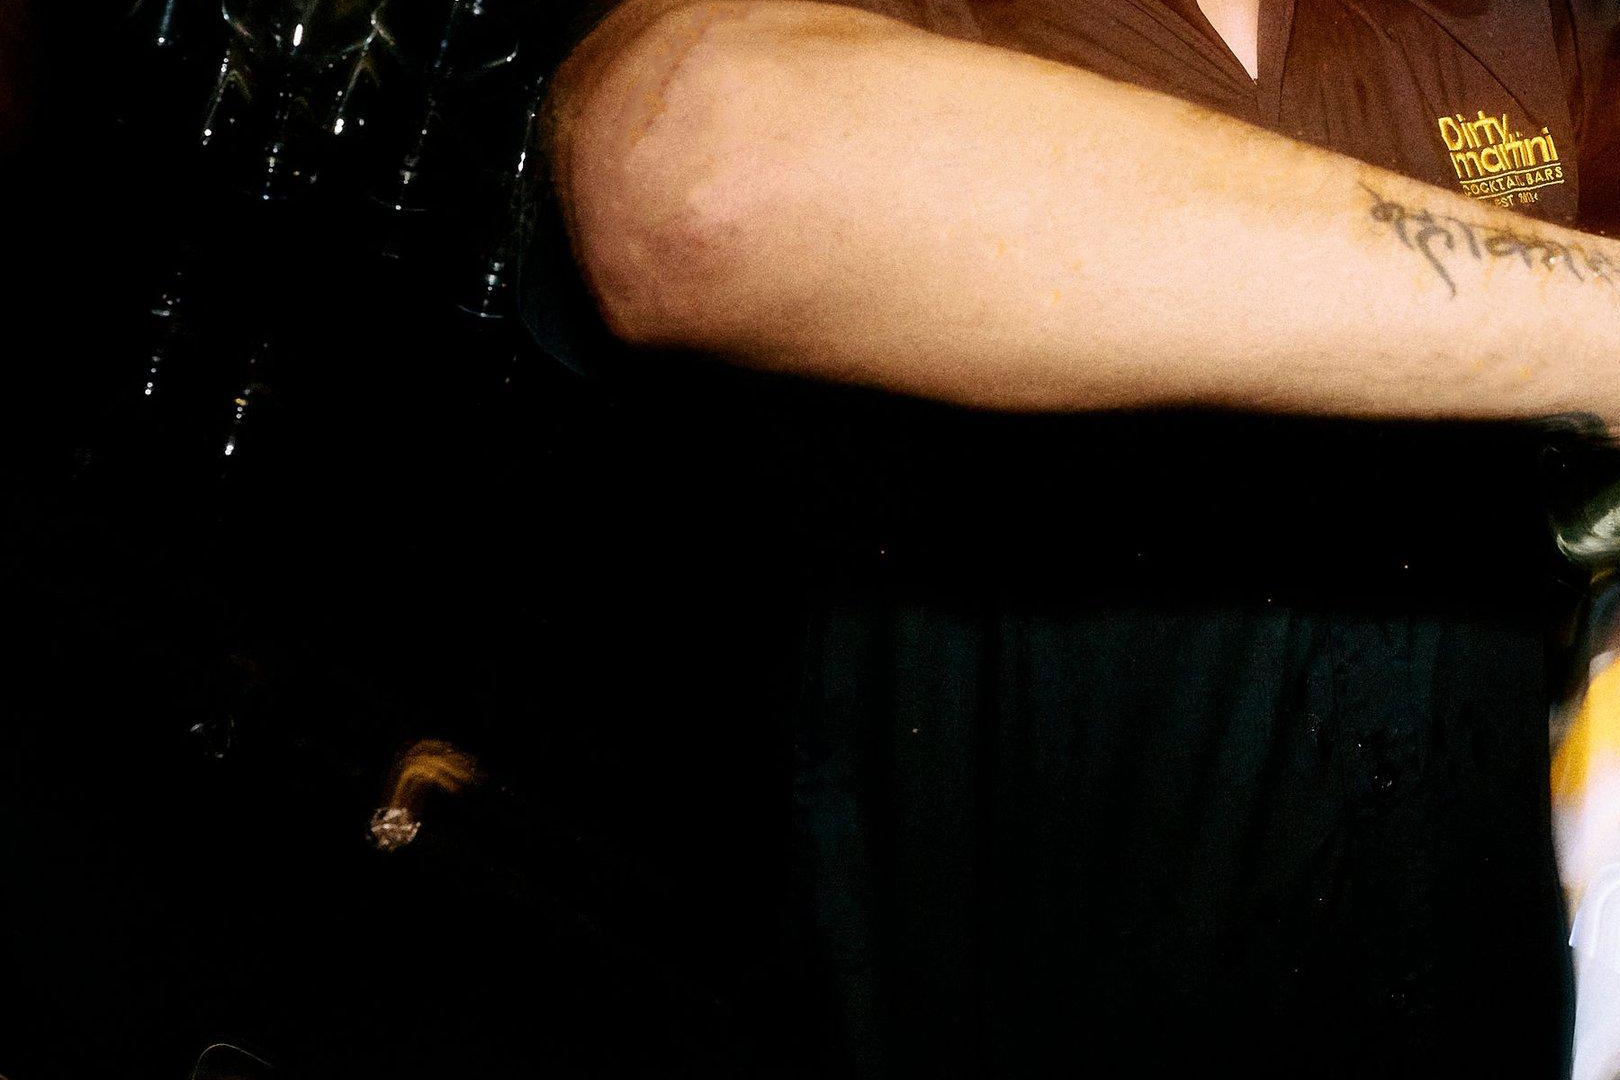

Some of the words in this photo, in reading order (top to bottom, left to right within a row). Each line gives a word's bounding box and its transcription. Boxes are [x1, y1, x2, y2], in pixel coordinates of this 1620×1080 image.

[1438, 110, 1508, 151] Dirty
[1450, 127, 1559, 179] martini
[1462, 176, 1525, 197] COCKTAIL
[1525, 166, 1563, 185] BARS
